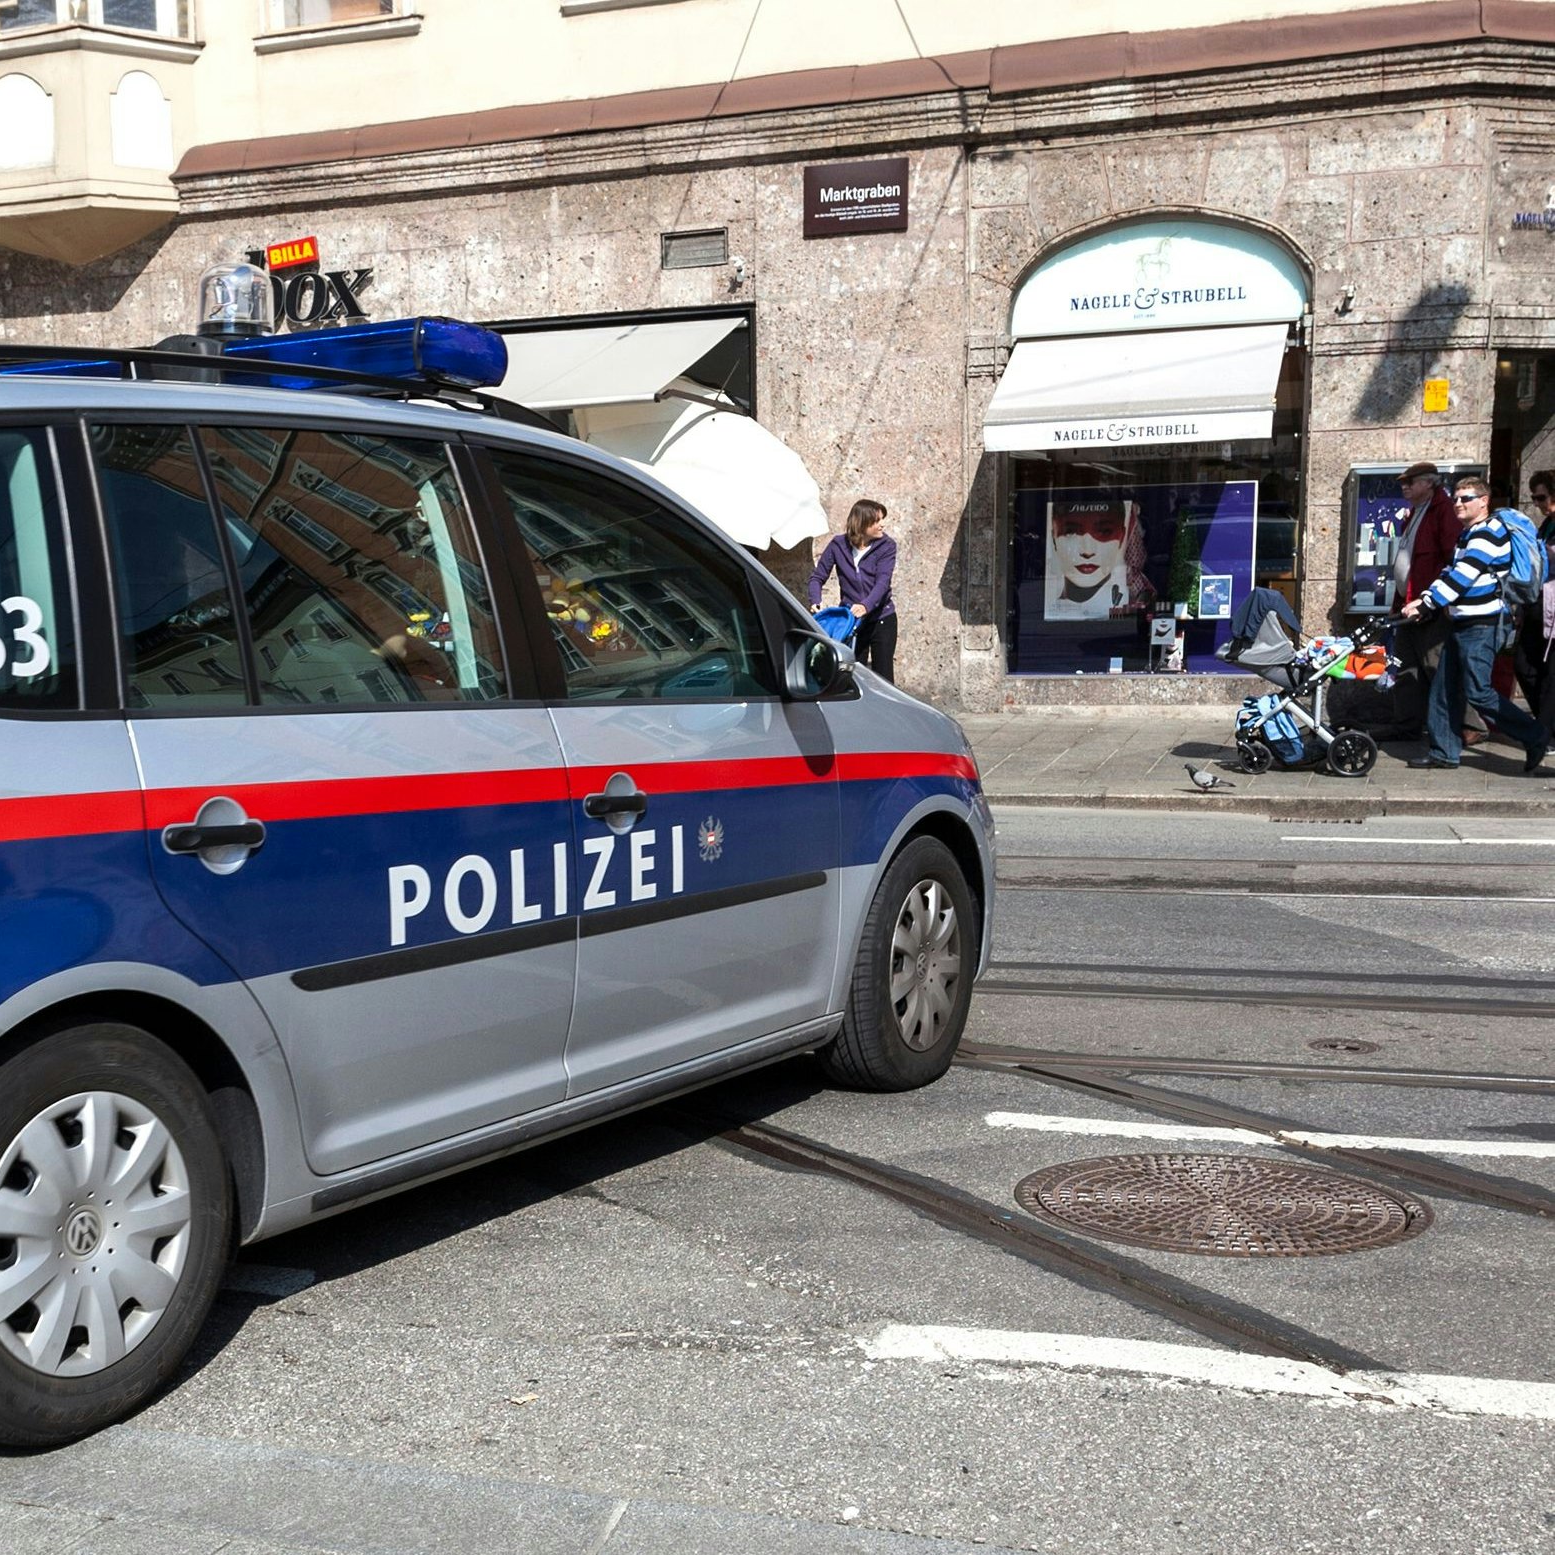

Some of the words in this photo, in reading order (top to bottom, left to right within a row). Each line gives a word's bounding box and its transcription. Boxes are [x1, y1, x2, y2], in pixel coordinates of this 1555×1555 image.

[819, 183, 901, 203] Marktgraben
[269, 242, 314, 266] BILLA
[1134, 287, 1159, 310] &
[1161, 286, 1247, 305] STRUBELL
[1106, 423, 1129, 442] &
[1128, 424, 1199, 438] STRUBELL
[1068, 503, 1110, 513] SHISEIDO
[388, 825, 684, 946] POLIZEI
